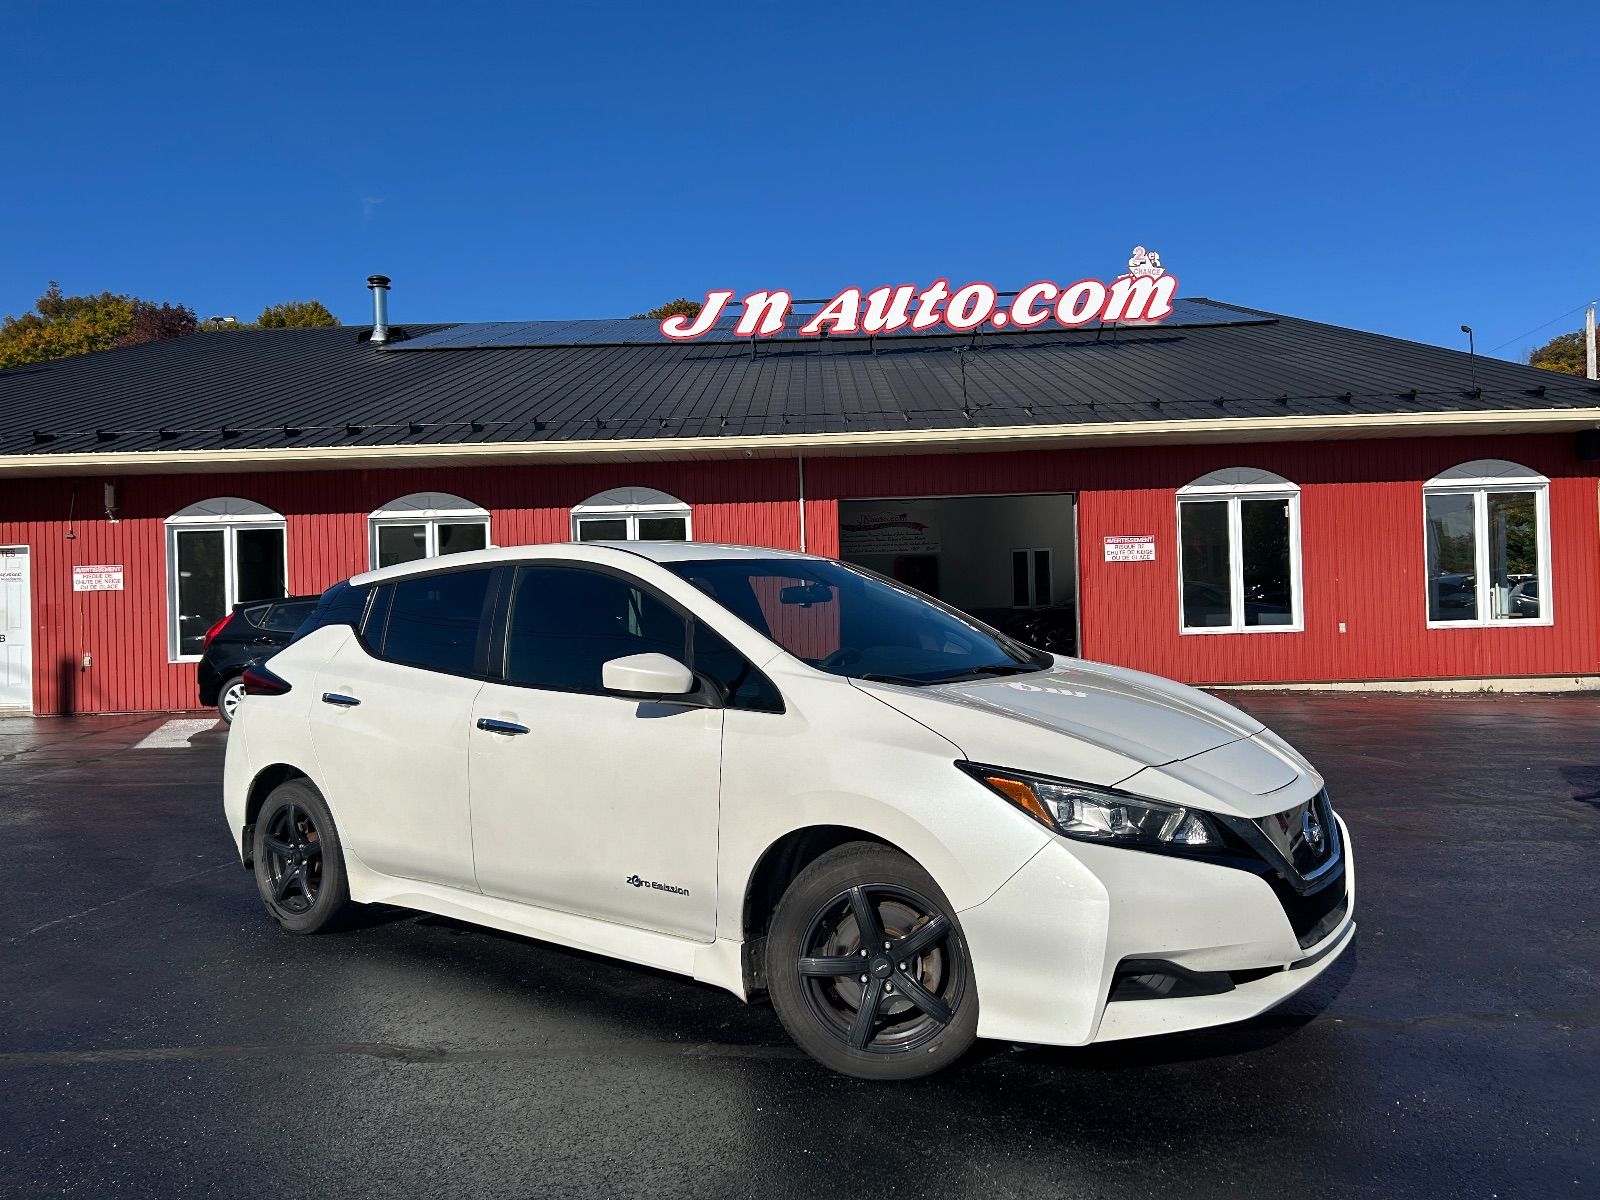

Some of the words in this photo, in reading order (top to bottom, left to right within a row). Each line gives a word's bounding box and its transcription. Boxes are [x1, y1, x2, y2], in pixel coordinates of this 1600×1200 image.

[1133, 268, 1161, 276] CHANCE
[800, 276, 1178, 334] Auto.com
[652, 881, 690, 897] Emission
